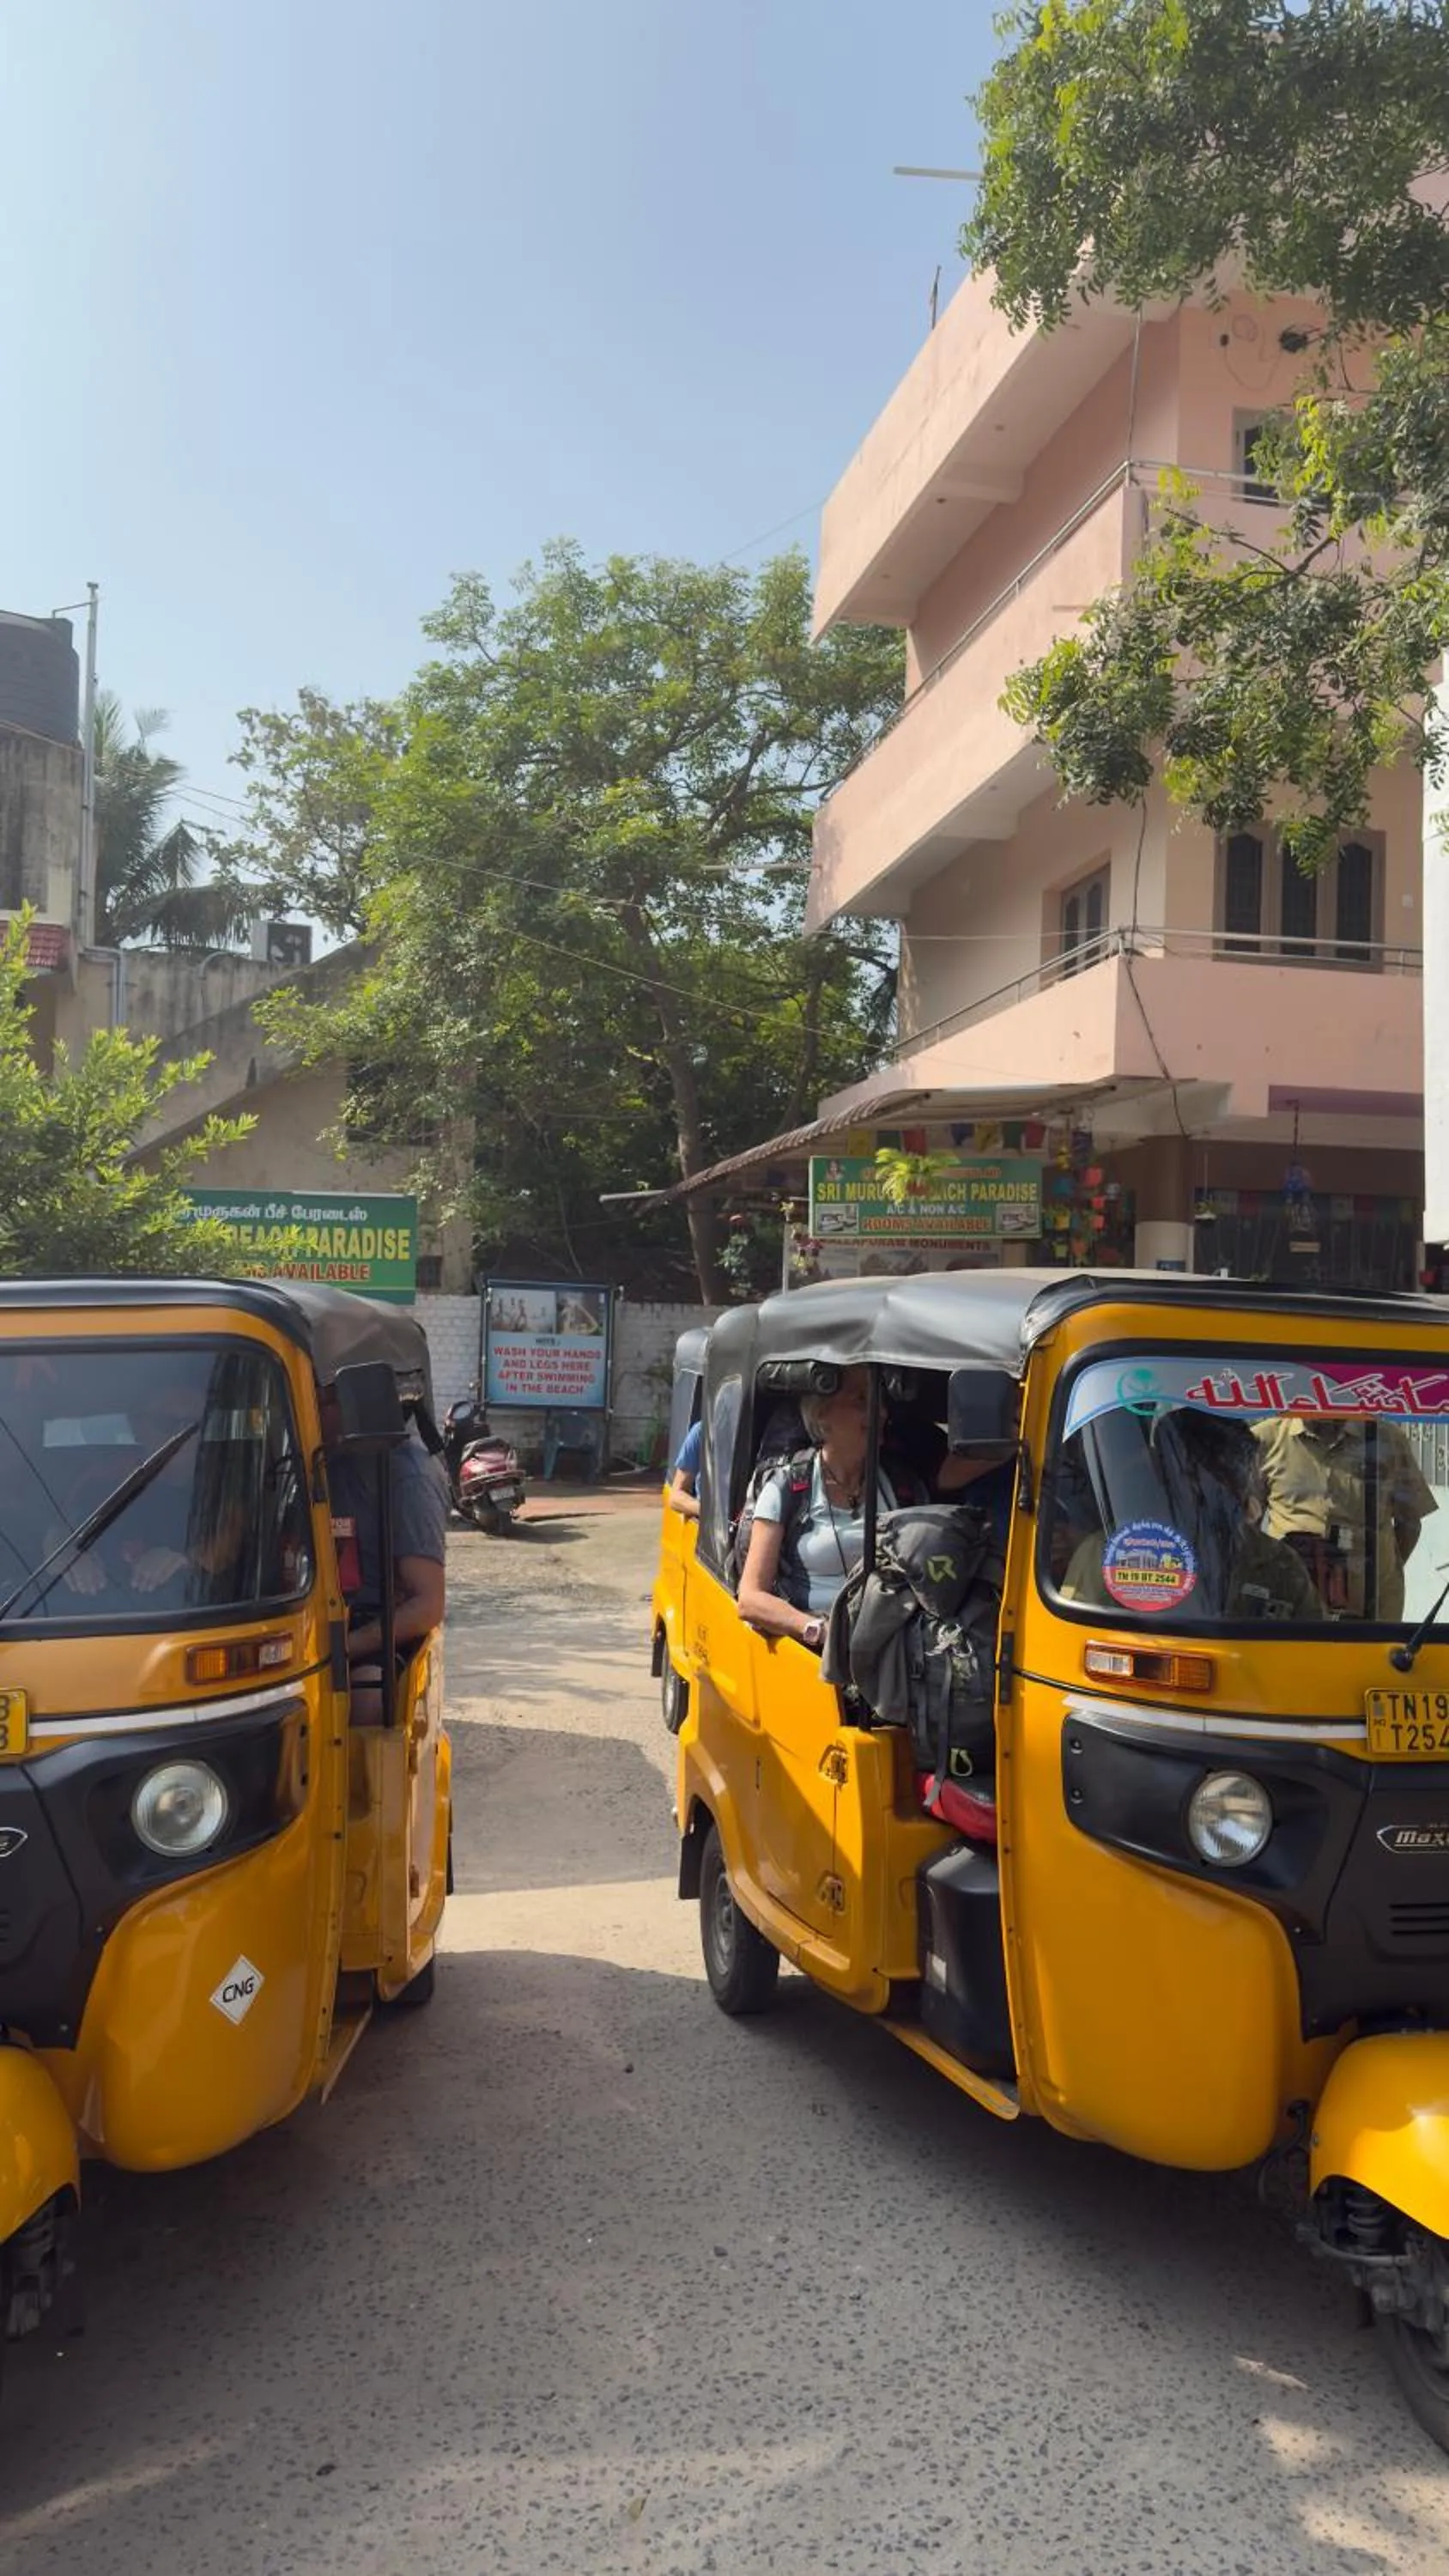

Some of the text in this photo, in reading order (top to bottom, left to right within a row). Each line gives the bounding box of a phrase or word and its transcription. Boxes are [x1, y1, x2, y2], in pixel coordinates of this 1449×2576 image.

[816, 1182, 840, 1201] SRI
[971, 1182, 1038, 1201] PARADISE
[919, 1204, 944, 1215] NON
[305, 1225, 409, 1261] PARADISE
[494, 1346, 601, 1358] WASH YOUR HANDS
[503, 1359, 591, 1371] AND LEGS HERE
[498, 1370, 595, 1383] AFTER SWIMMING
[506, 1383, 584, 1394] IN THE BEACH
[223, 1976, 255, 2003] CNG
